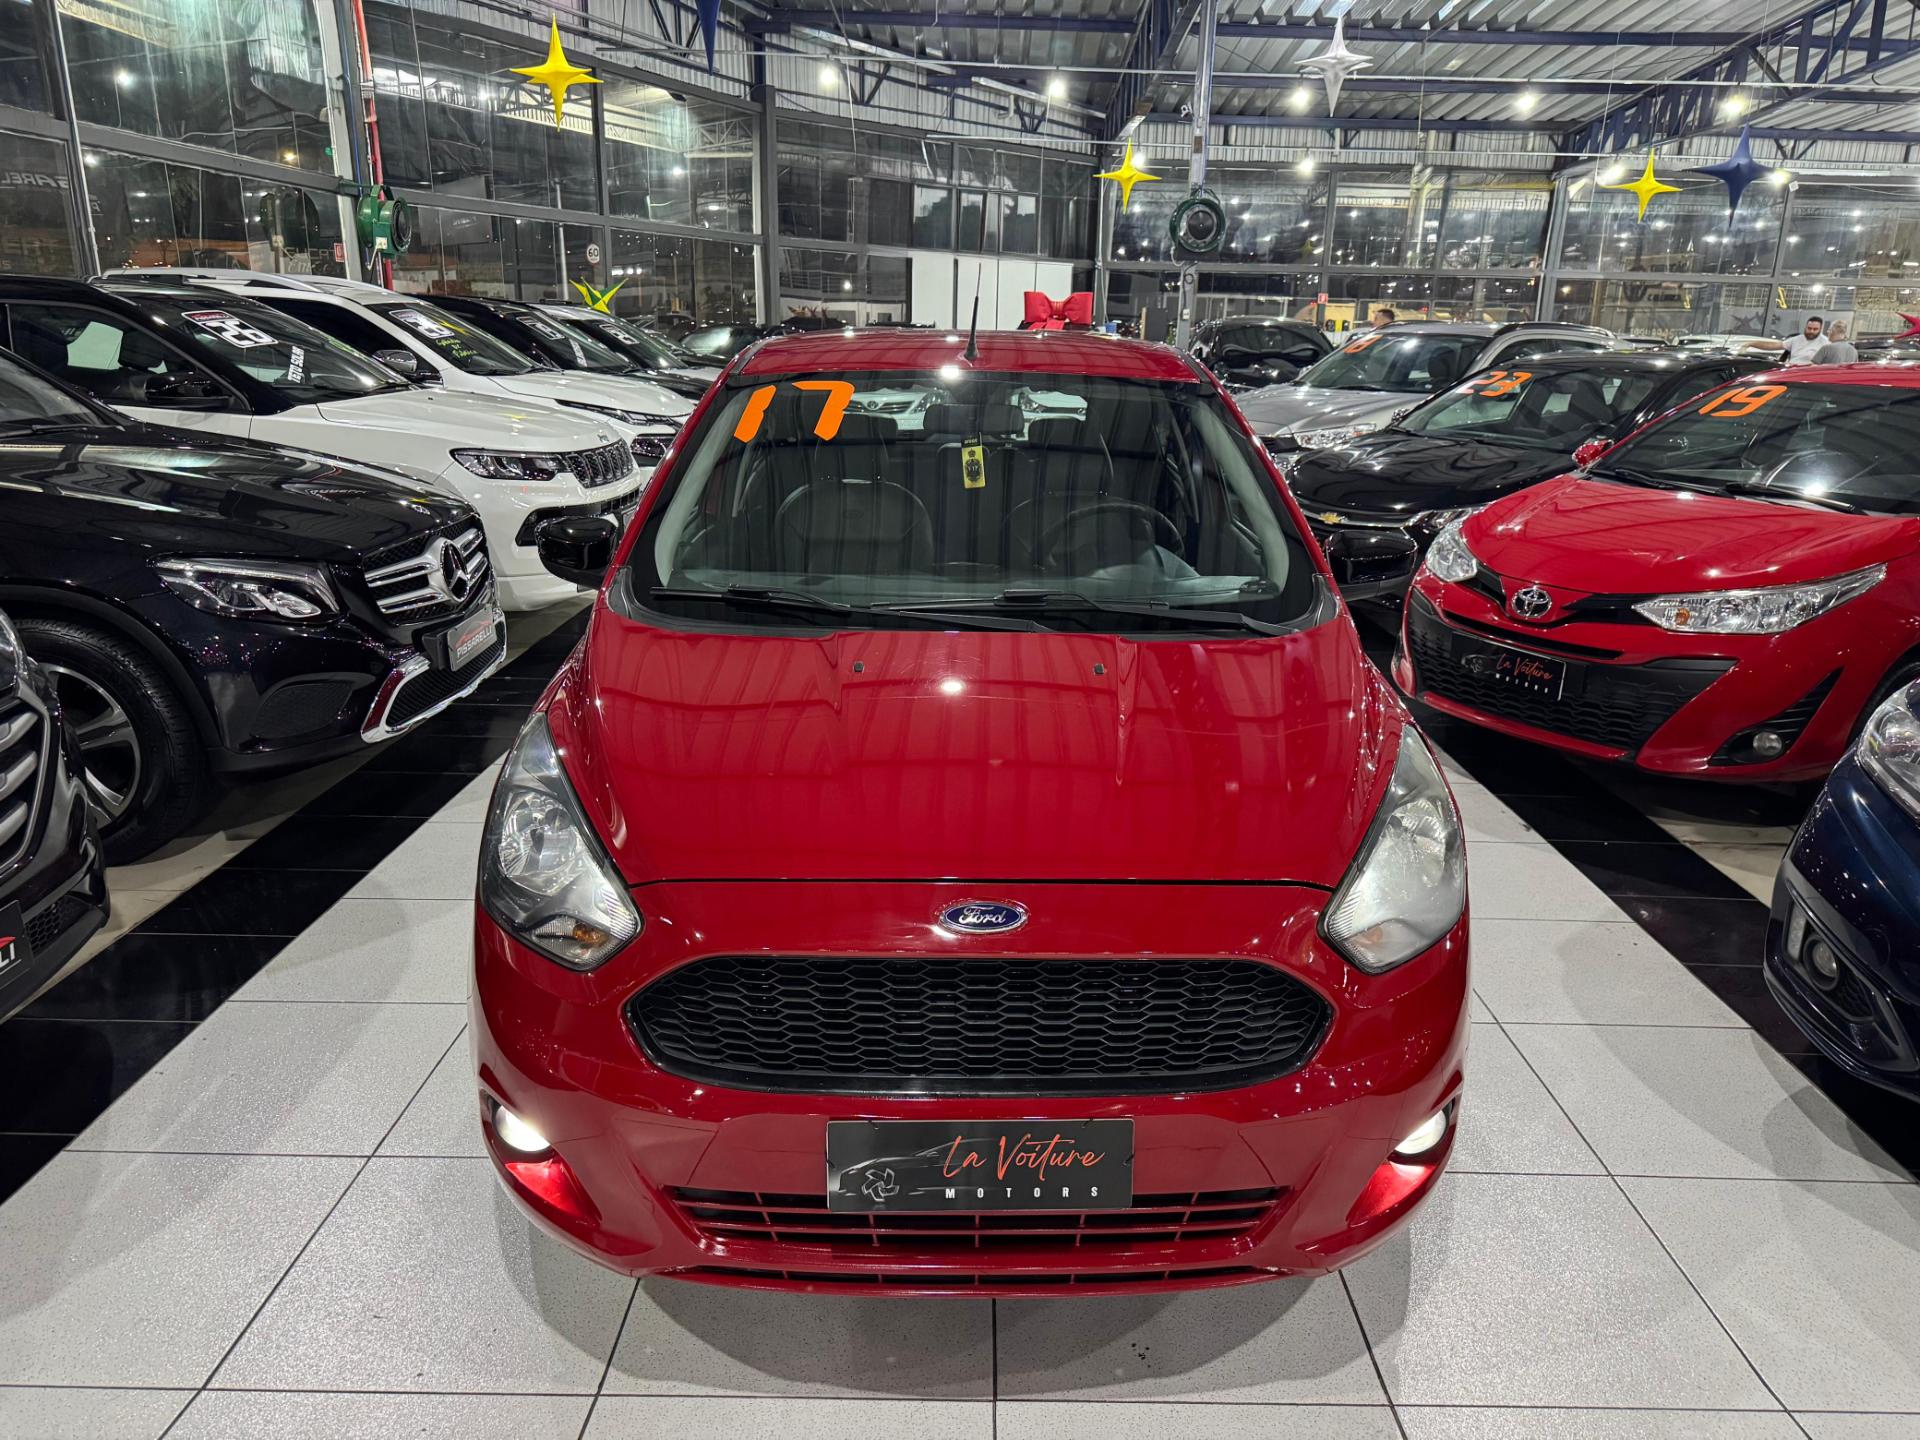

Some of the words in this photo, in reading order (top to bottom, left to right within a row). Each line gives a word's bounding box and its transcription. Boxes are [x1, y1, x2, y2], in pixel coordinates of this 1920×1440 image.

[1456, 371, 1532, 397] 23
[734, 380, 856, 443] 17
[1698, 385, 1788, 417] 19
[456, 625, 493, 659] PISSARELLI
[958, 905, 1007, 925] Ford
[943, 1135, 988, 1178] La
[997, 1133, 1106, 1182] Voiture
[945, 1186, 1099, 1200] MOTORS
